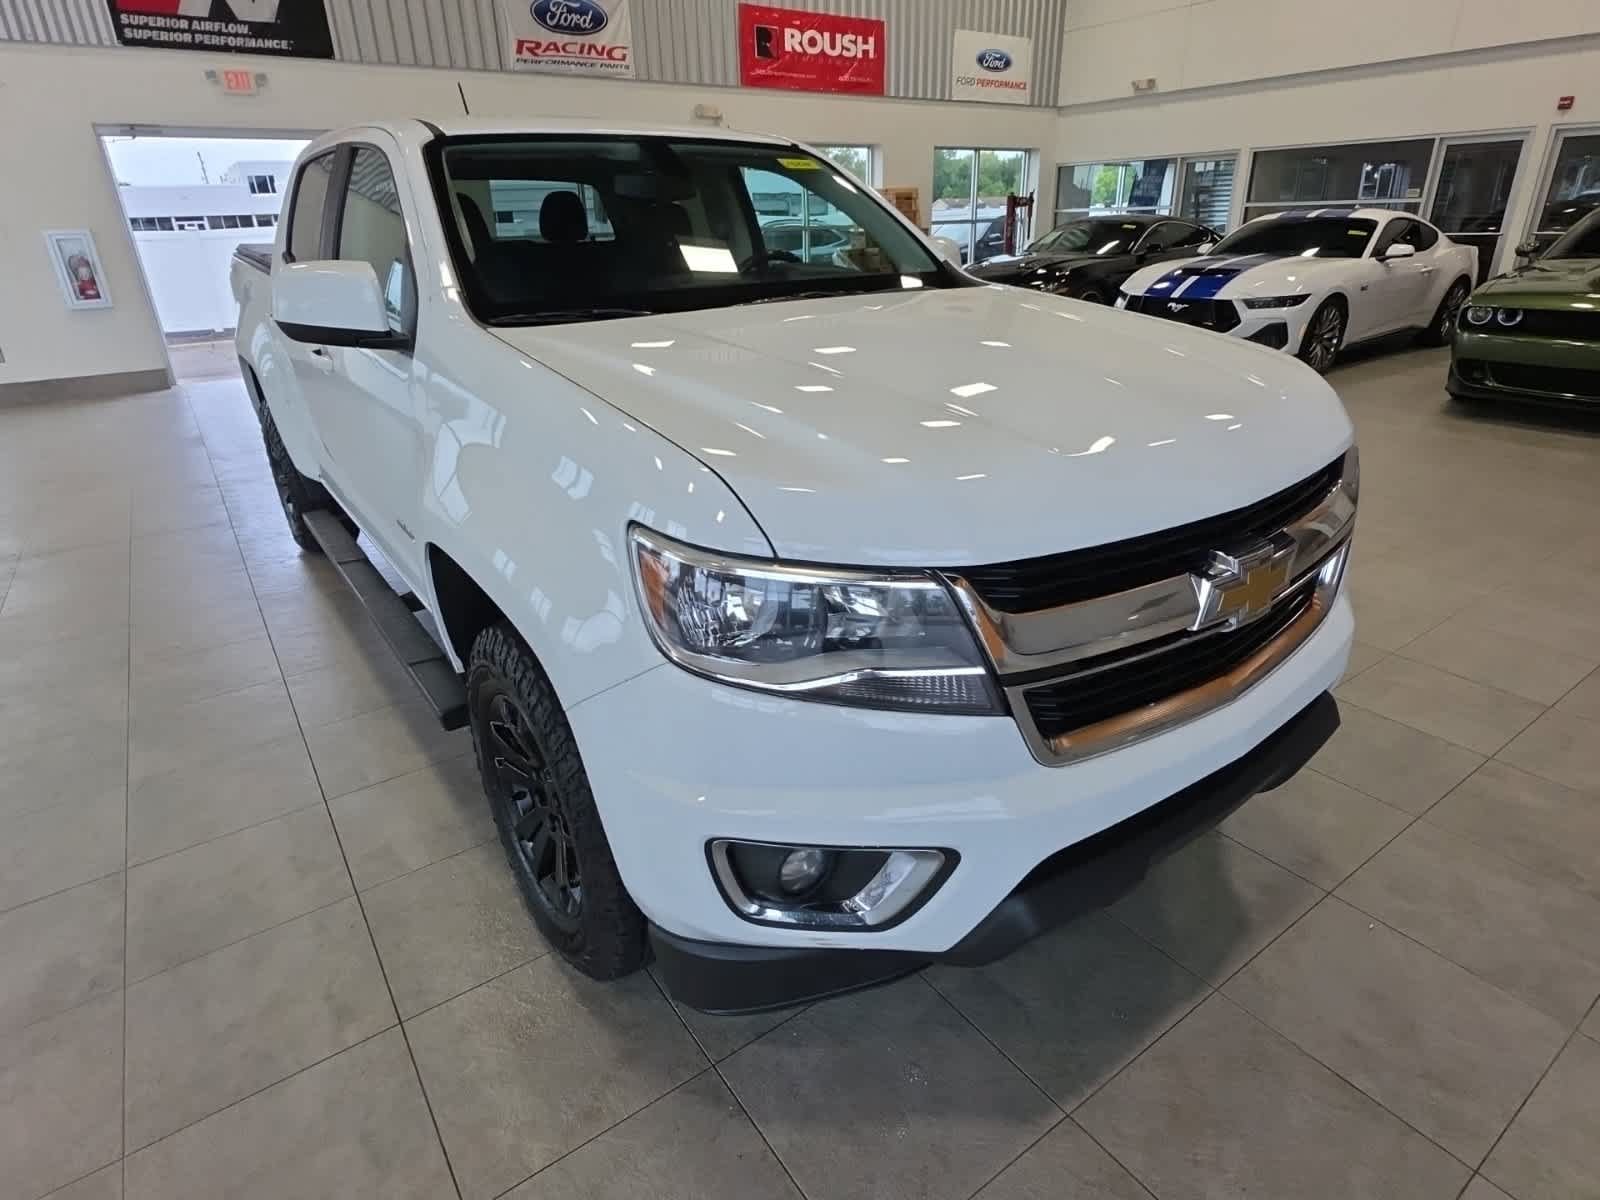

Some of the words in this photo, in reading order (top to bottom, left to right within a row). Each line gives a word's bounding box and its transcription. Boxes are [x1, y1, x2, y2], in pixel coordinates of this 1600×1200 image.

[545, 0, 594, 28] Ford
[120, 13, 189, 29] SUPERIOR
[191, 20, 252, 35] AIRFLOW.
[124, 28, 193, 43] SUPERIOR
[784, 27, 875, 59] ROUSH
[516, 39, 628, 61] RACING
[516, 58, 596, 68] PERFORMANCE
[983, 52, 1006, 68] Ford
[956, 76, 976, 87] FORD
[976, 78, 1027, 90] PERFORMANCE
